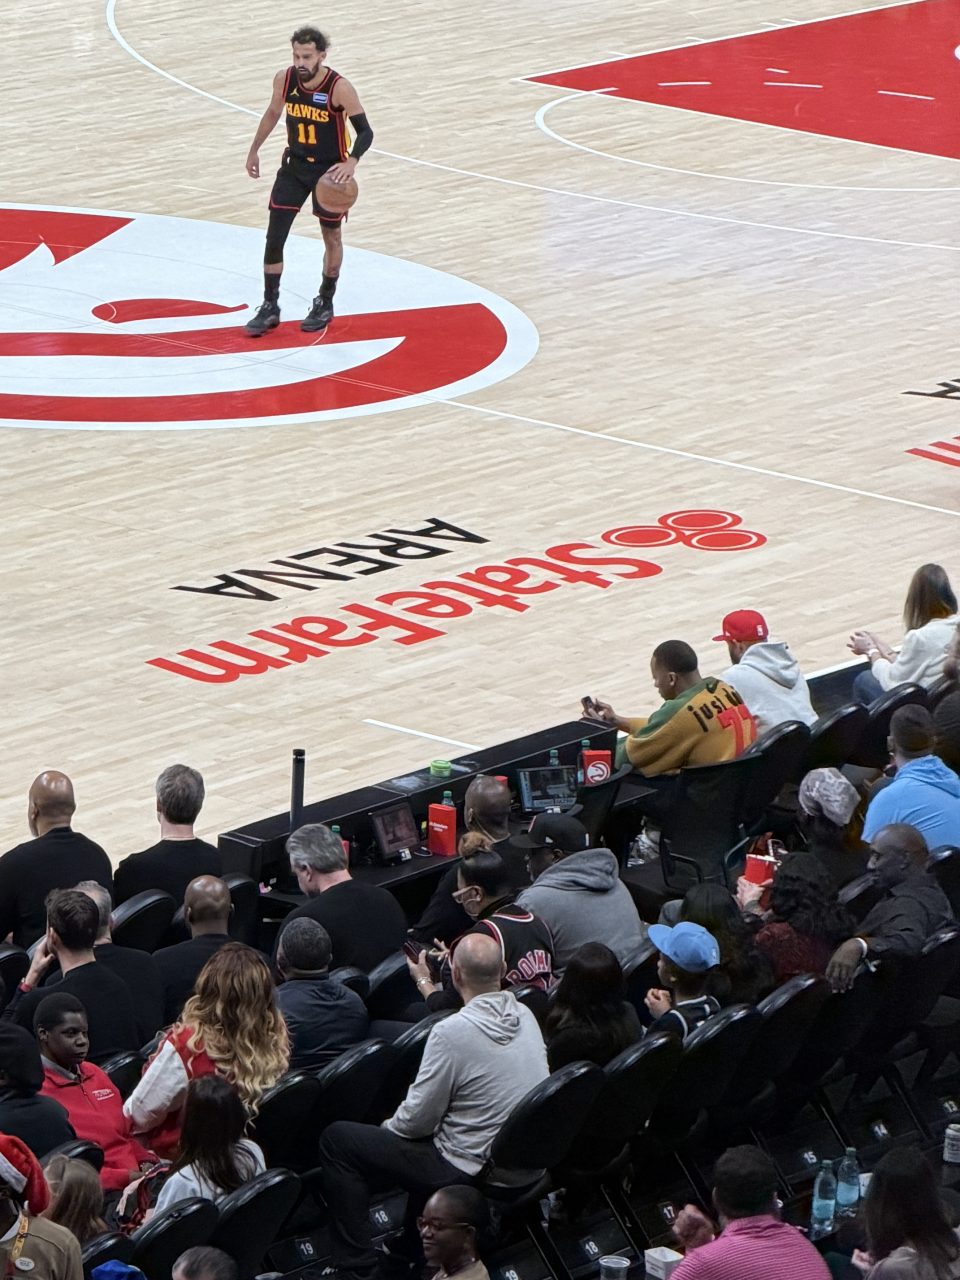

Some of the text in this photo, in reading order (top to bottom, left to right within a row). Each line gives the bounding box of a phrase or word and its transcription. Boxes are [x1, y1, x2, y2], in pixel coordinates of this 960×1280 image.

[286, 103, 330, 123] HAWKS
[297, 123, 317, 144] 11
[169, 517, 490, 602] ARENA
[804, 1151, 817, 1164] 15
[375, 1210, 389, 1224] 18
[663, 1206, 675, 1219] 17
[301, 1242, 314, 1255] 19
[585, 1241, 599, 1255] 18
